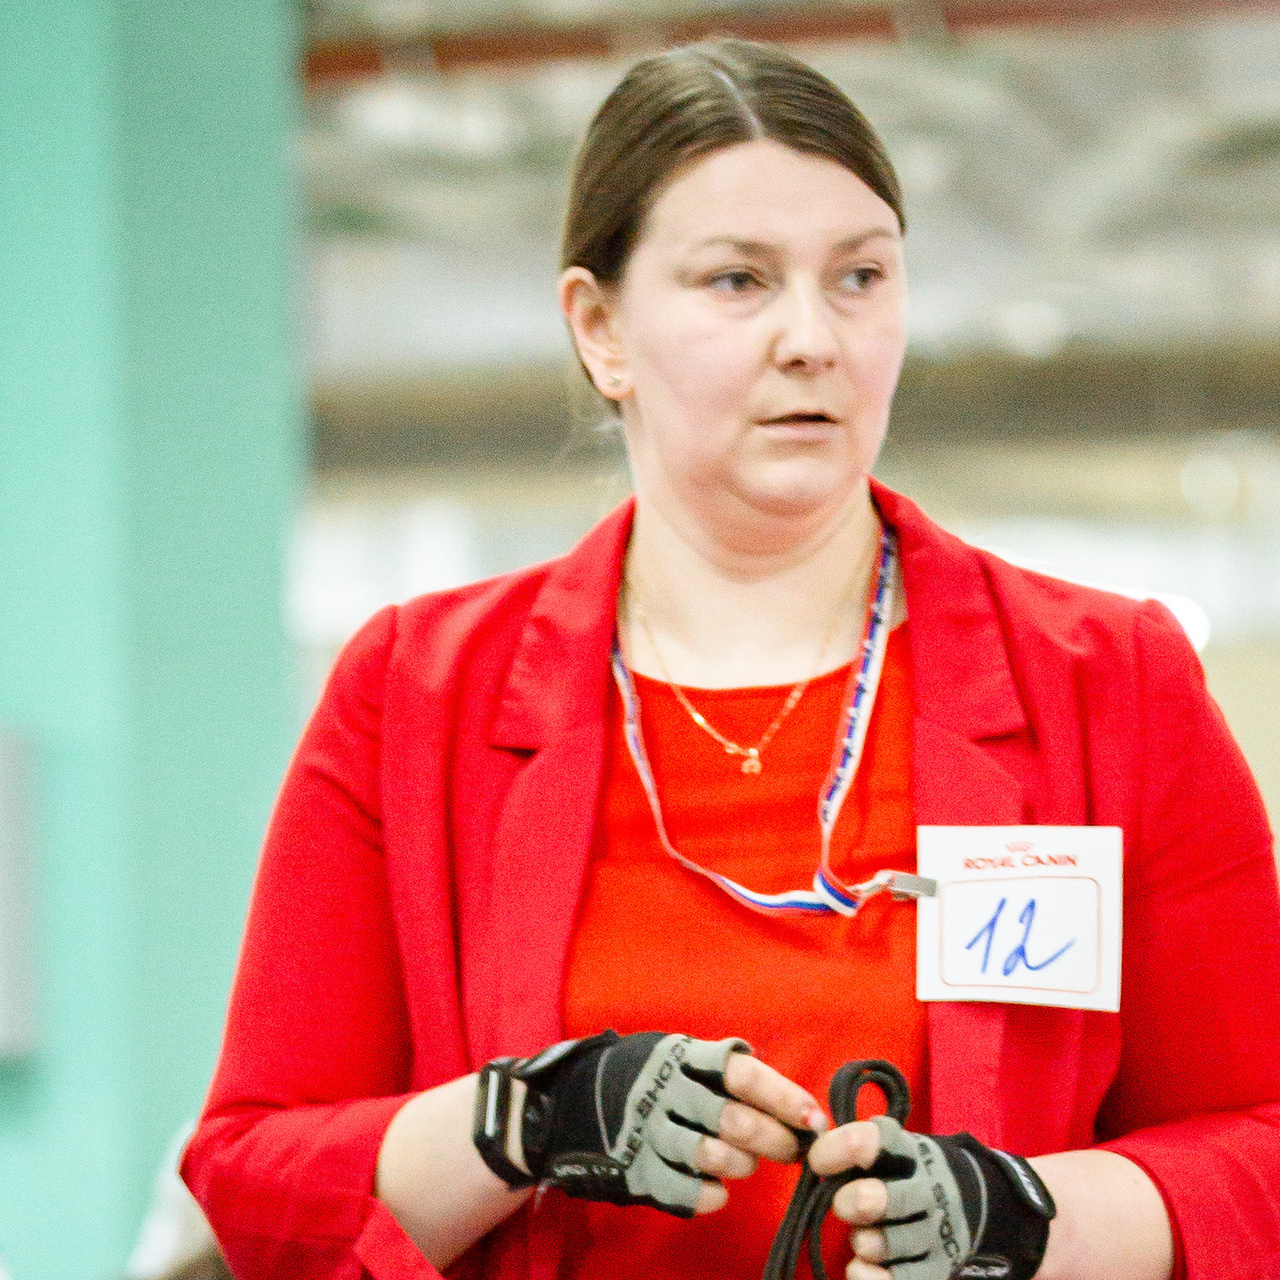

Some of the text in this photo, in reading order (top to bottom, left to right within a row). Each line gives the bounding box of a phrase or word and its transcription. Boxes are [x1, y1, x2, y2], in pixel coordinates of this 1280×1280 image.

[963, 853, 1078, 870] ROYAL CANIN
[965, 897, 1076, 977] 12
